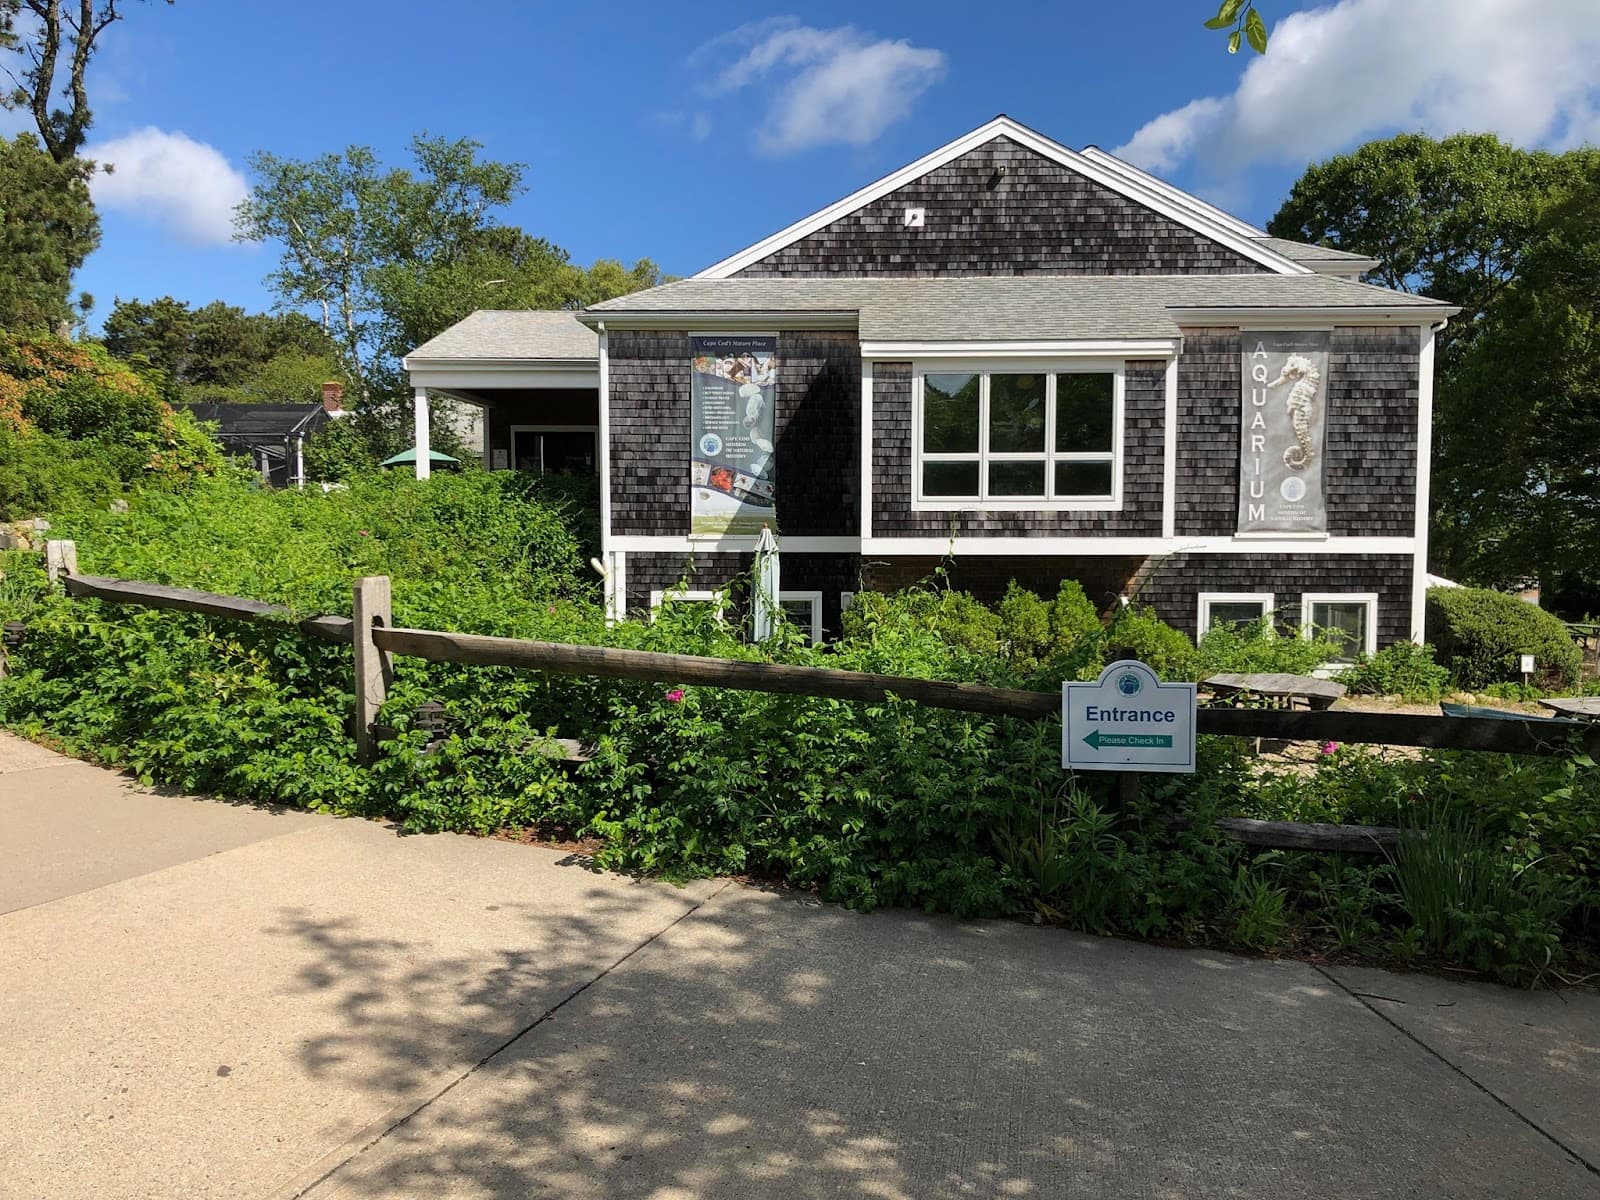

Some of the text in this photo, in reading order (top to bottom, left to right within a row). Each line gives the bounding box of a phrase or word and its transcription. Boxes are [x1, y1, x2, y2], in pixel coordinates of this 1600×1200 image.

[703, 340, 716, 348] Cape
[1248, 341, 1268, 521] AQUARIUM
[1086, 706, 1175, 723] Entrance
[1099, 736, 1164, 745] Please Check In
